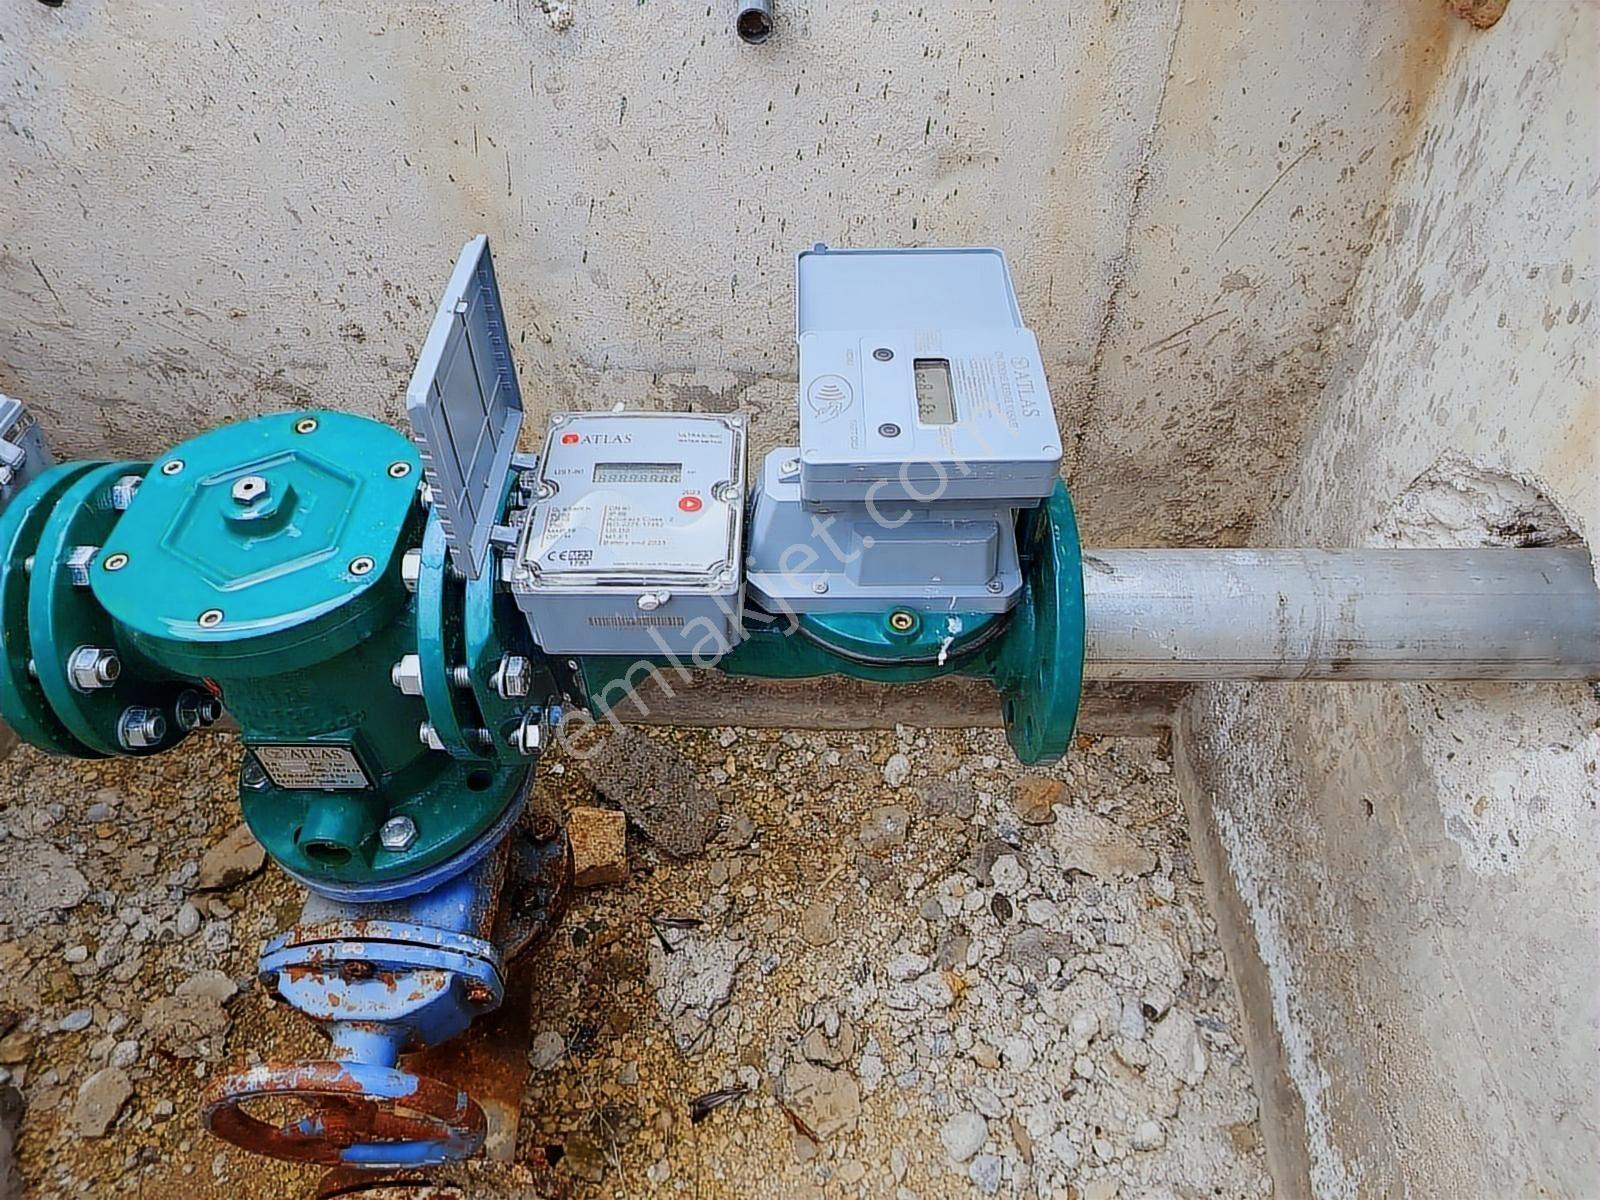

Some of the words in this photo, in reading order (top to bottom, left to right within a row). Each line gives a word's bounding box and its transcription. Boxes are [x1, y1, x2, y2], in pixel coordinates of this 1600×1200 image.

[1014, 370, 1040, 418] ATLAS
[580, 434, 632, 445] ATLAS
[290, 749, 343, 760] ATLAS
